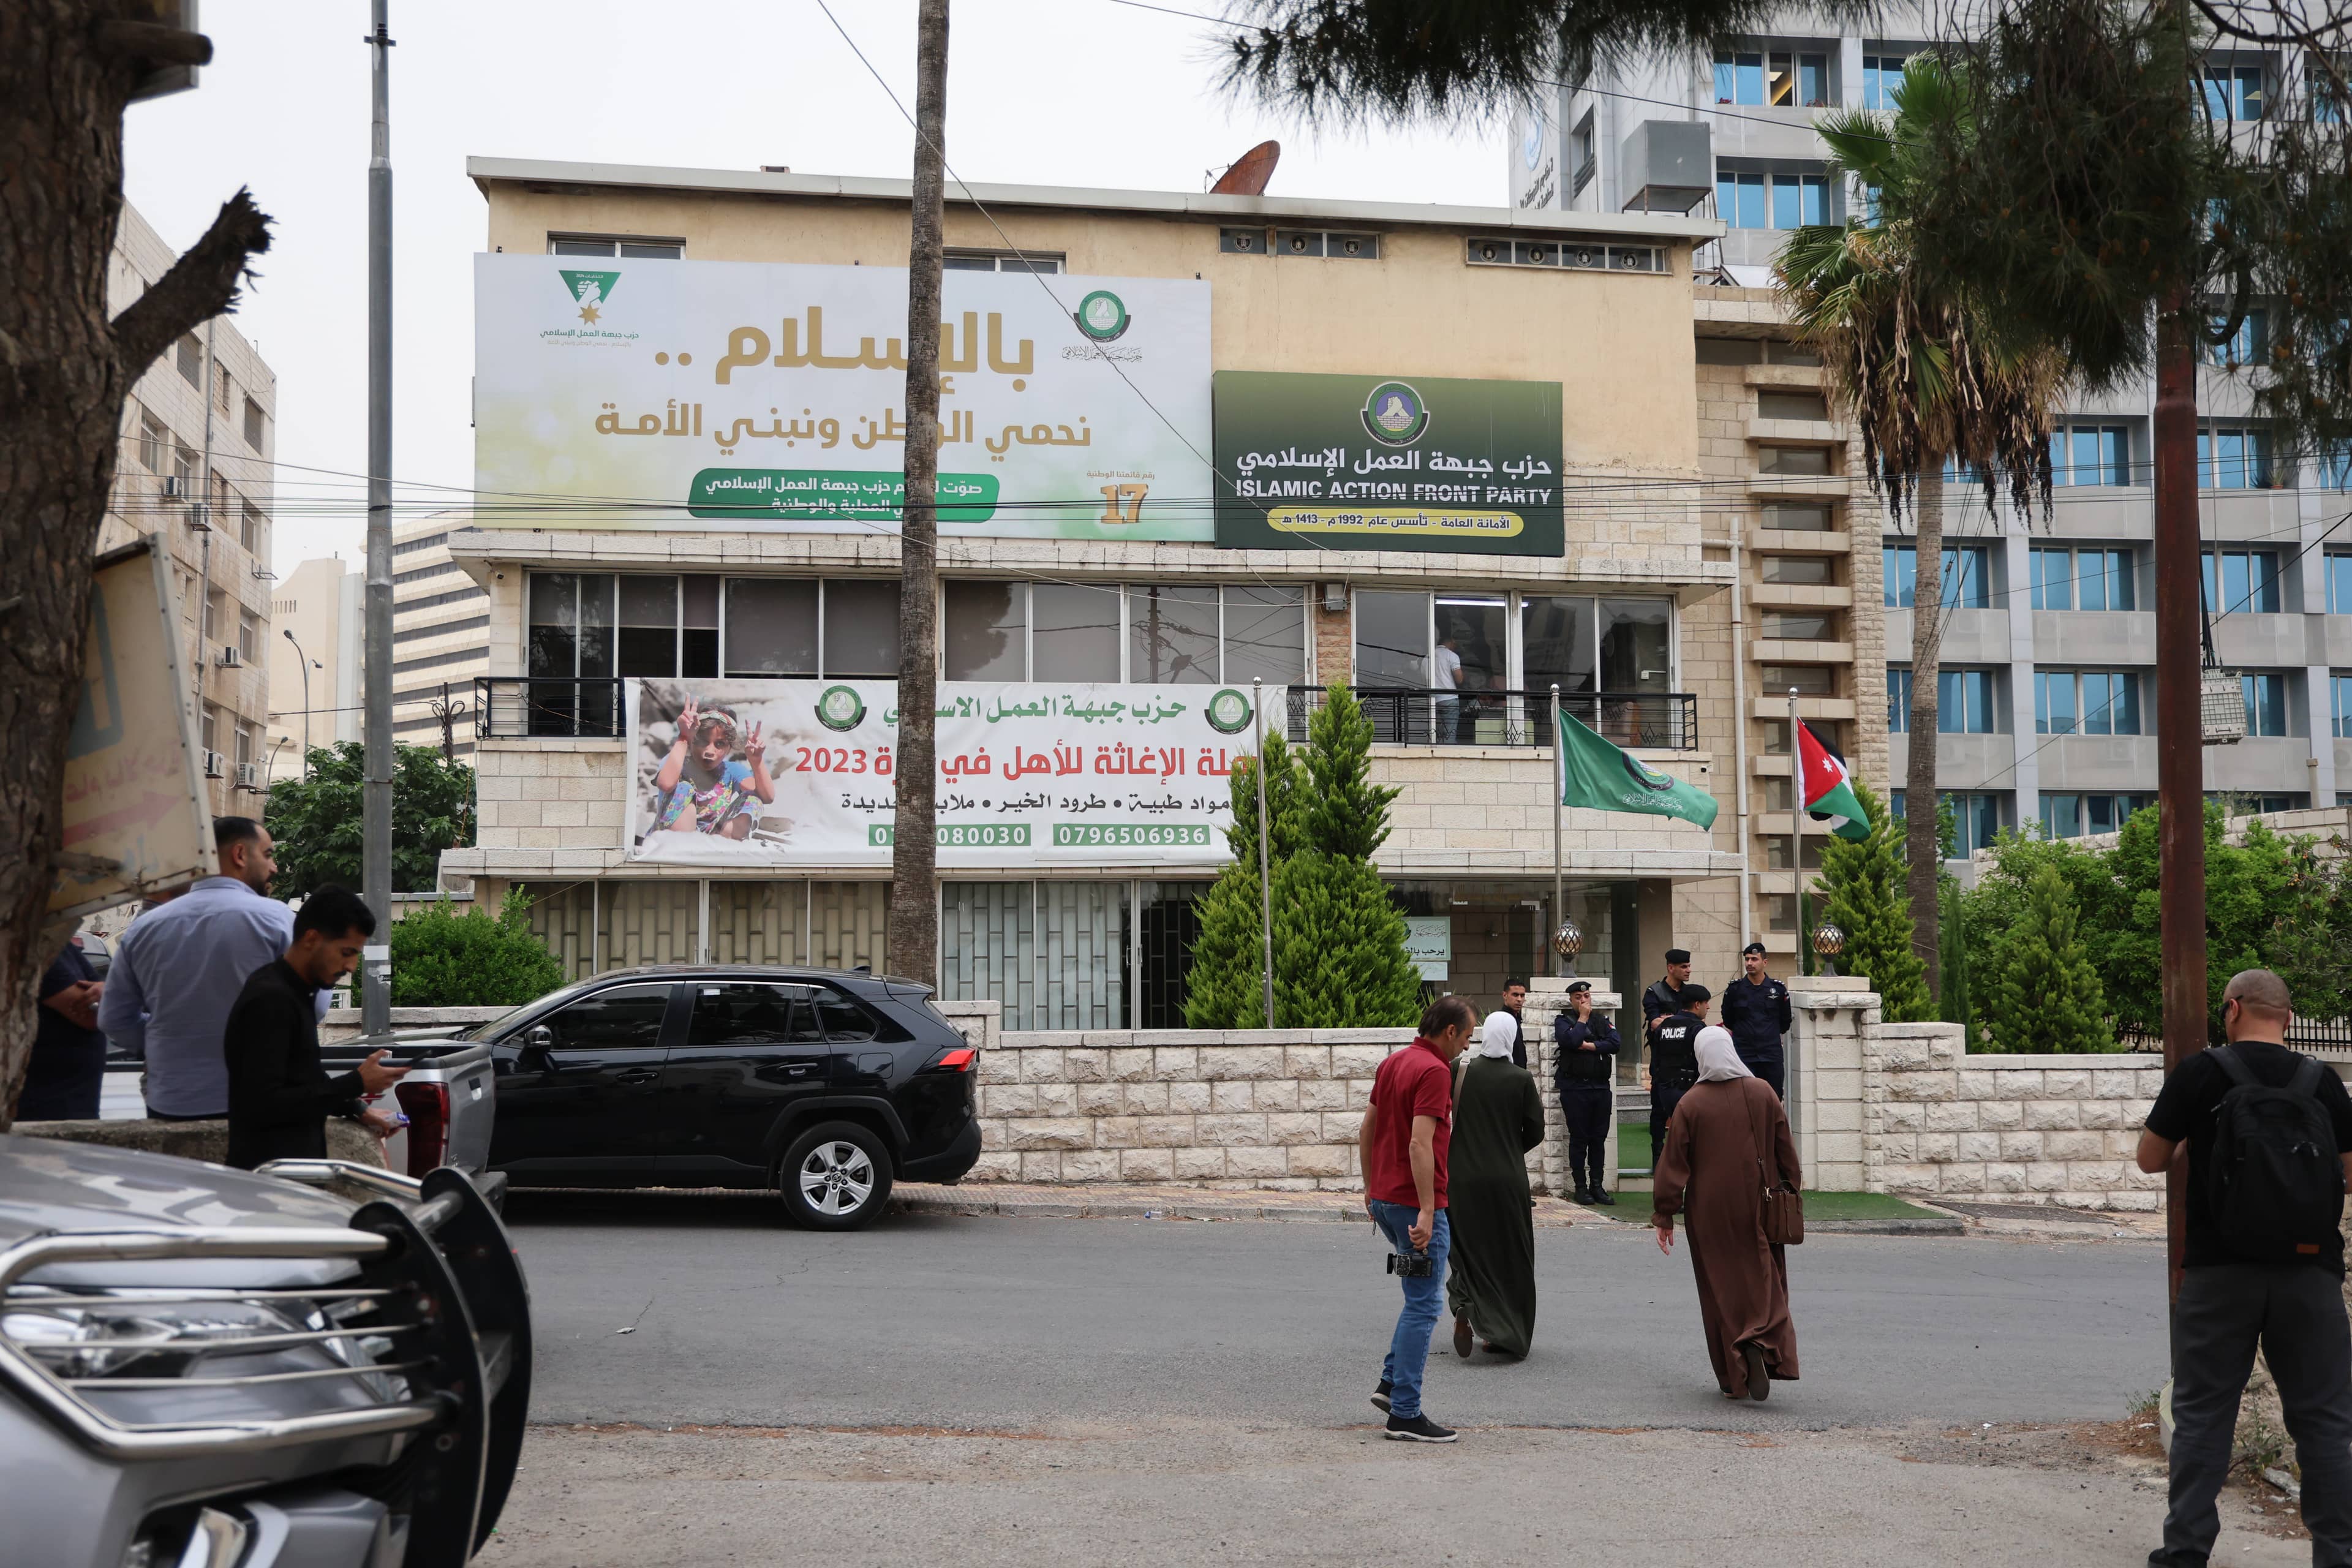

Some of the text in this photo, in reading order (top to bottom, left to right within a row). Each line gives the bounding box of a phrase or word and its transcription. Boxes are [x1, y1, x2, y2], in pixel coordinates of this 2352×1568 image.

[540, 329, 575, 338] الإسلامي
[577, 330, 600, 338] العمل
[601, 331, 622, 339] جبهة
[595, 398, 703, 437] الأمة
[714, 407, 840, 456] ونبني
[985, 417, 1090, 462] نحمي
[1236, 447, 1552, 480] حزب جبهة العمل الإسلامي
[1087, 470, 1115, 478] الوطنية
[1142, 471, 1155, 480] رقم
[706, 477, 772, 494] الإسلامي
[775, 477, 817, 492] العمل
[821, 478, 860, 494] جبهة
[862, 480, 891, 494] حزب
[1236, 479, 1552, 505] ISLAMIC ACTION FRONT PARTY
[1100, 483, 1148, 524] 17
[1295, 514, 1318, 524] 1413
[1338, 514, 1363, 525] 1992
[1368, 515, 1387, 527] عام
[1391, 513, 1428, 528] تأسس
[1441, 517, 1473, 528] العامة
[1477, 514, 1510, 529] الأمانة
[883, 696, 981, 728] الاسي
[986, 695, 1057, 724] العمل
[1062, 694, 1126, 725] جبهة
[1132, 693, 1186, 725] حزب
[796, 747, 867, 774] 2023
[941, 746, 991, 784] في
[1003, 738, 1083, 781] للأهل
[1095, 741, 1185, 785] الإغاثة
[842, 791, 1231, 815] مواد طبية طرود الخير ملاب ديدة
[875, 826, 1205, 845] 0080030 0796506936
[1661, 1027, 1687, 1039] POLICE
